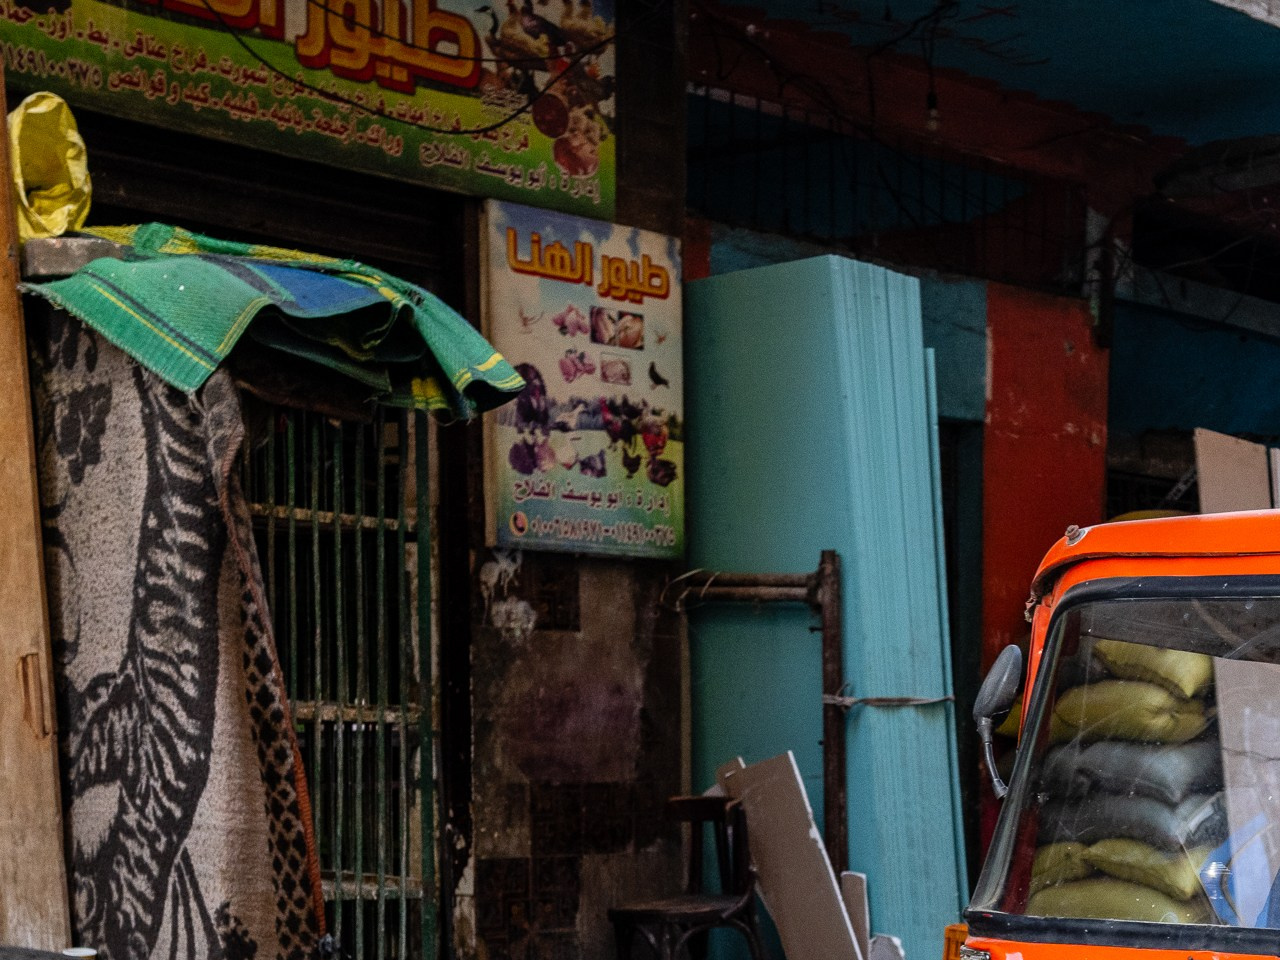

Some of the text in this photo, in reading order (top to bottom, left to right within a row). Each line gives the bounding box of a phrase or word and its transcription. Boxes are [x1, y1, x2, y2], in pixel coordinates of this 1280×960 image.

[86, 18, 110, 53] بط
[170, 43, 209, 74] فراخ
[419, 142, 470, 170] الفلاح
[475, 151, 524, 187] يوسف
[507, 226, 670, 304] طيور الهنا
[512, 478, 556, 503] الفلاح
[560, 480, 604, 510] يوسف
